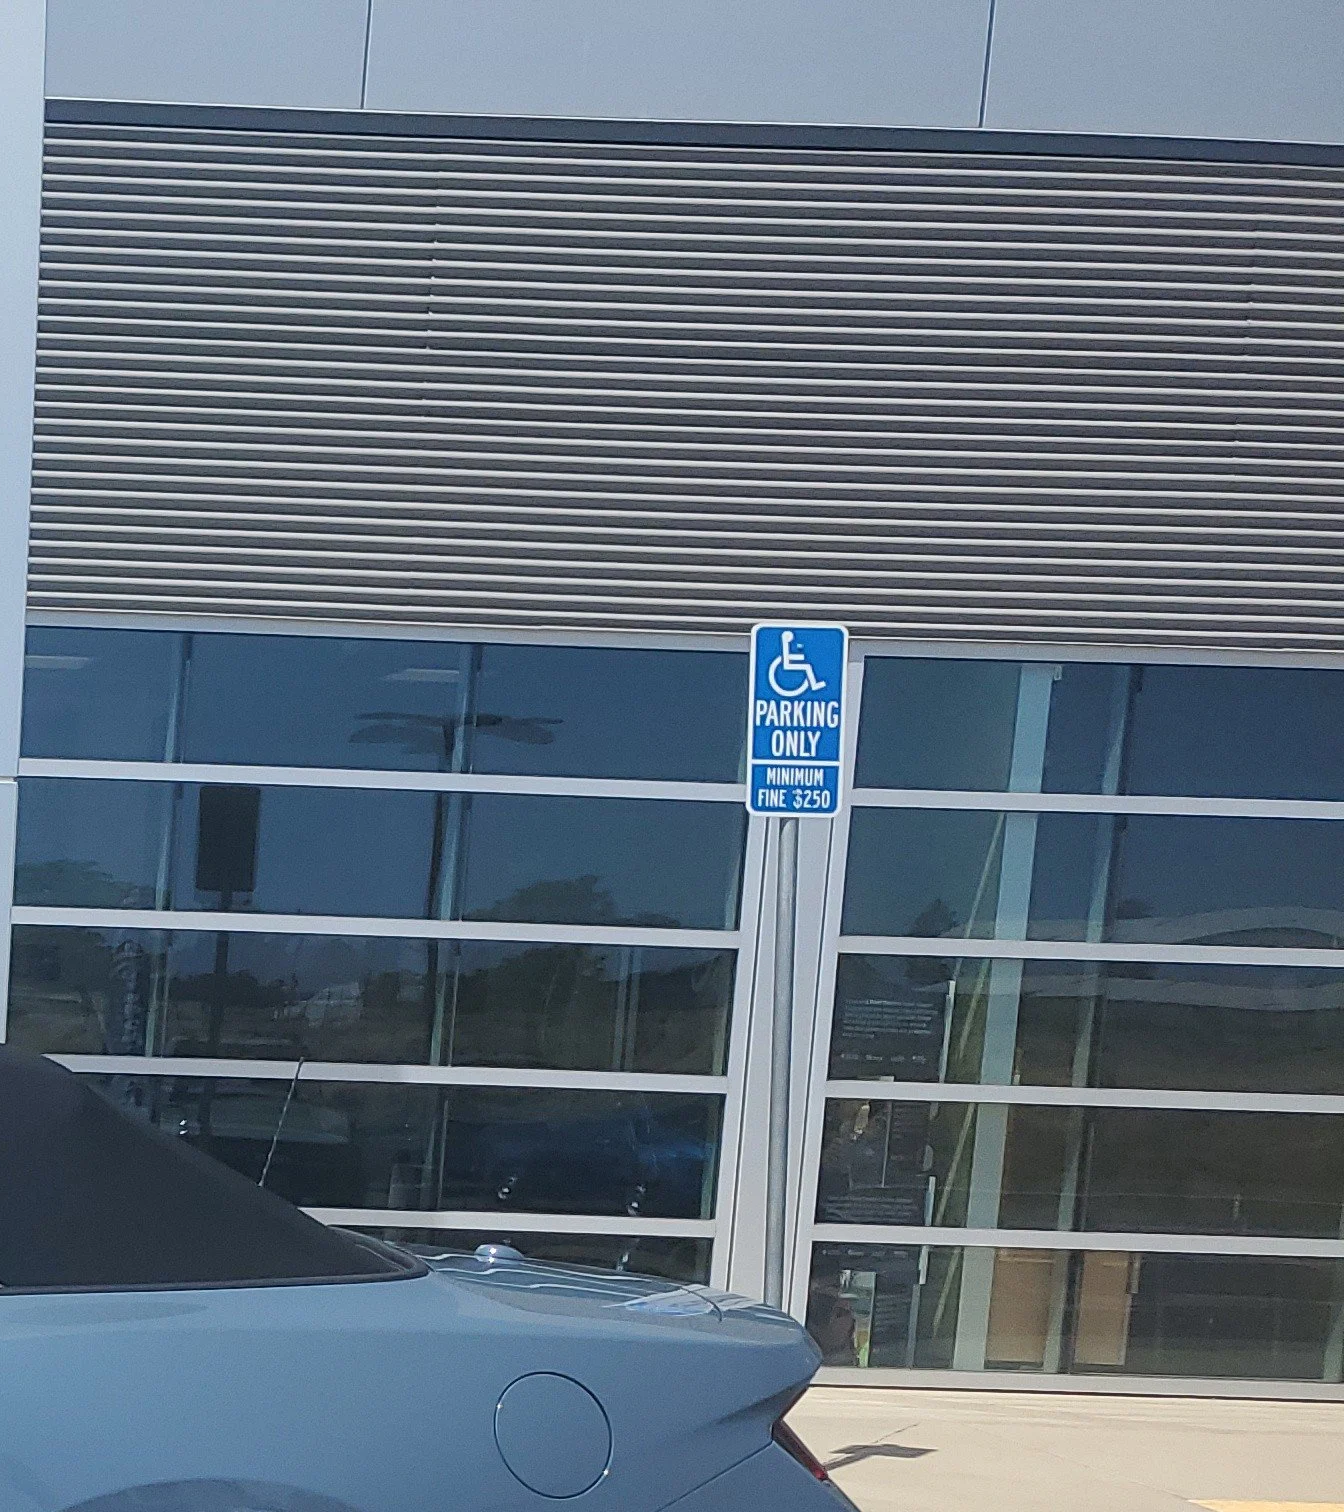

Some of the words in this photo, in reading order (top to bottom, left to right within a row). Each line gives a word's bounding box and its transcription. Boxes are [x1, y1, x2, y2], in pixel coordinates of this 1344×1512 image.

[756, 700, 839, 728] PARKING
[771, 730, 821, 757] ONLY
[766, 768, 824, 786] MINIMUM
[757, 789, 786, 808] FINE
[792, 789, 830, 809] $250
